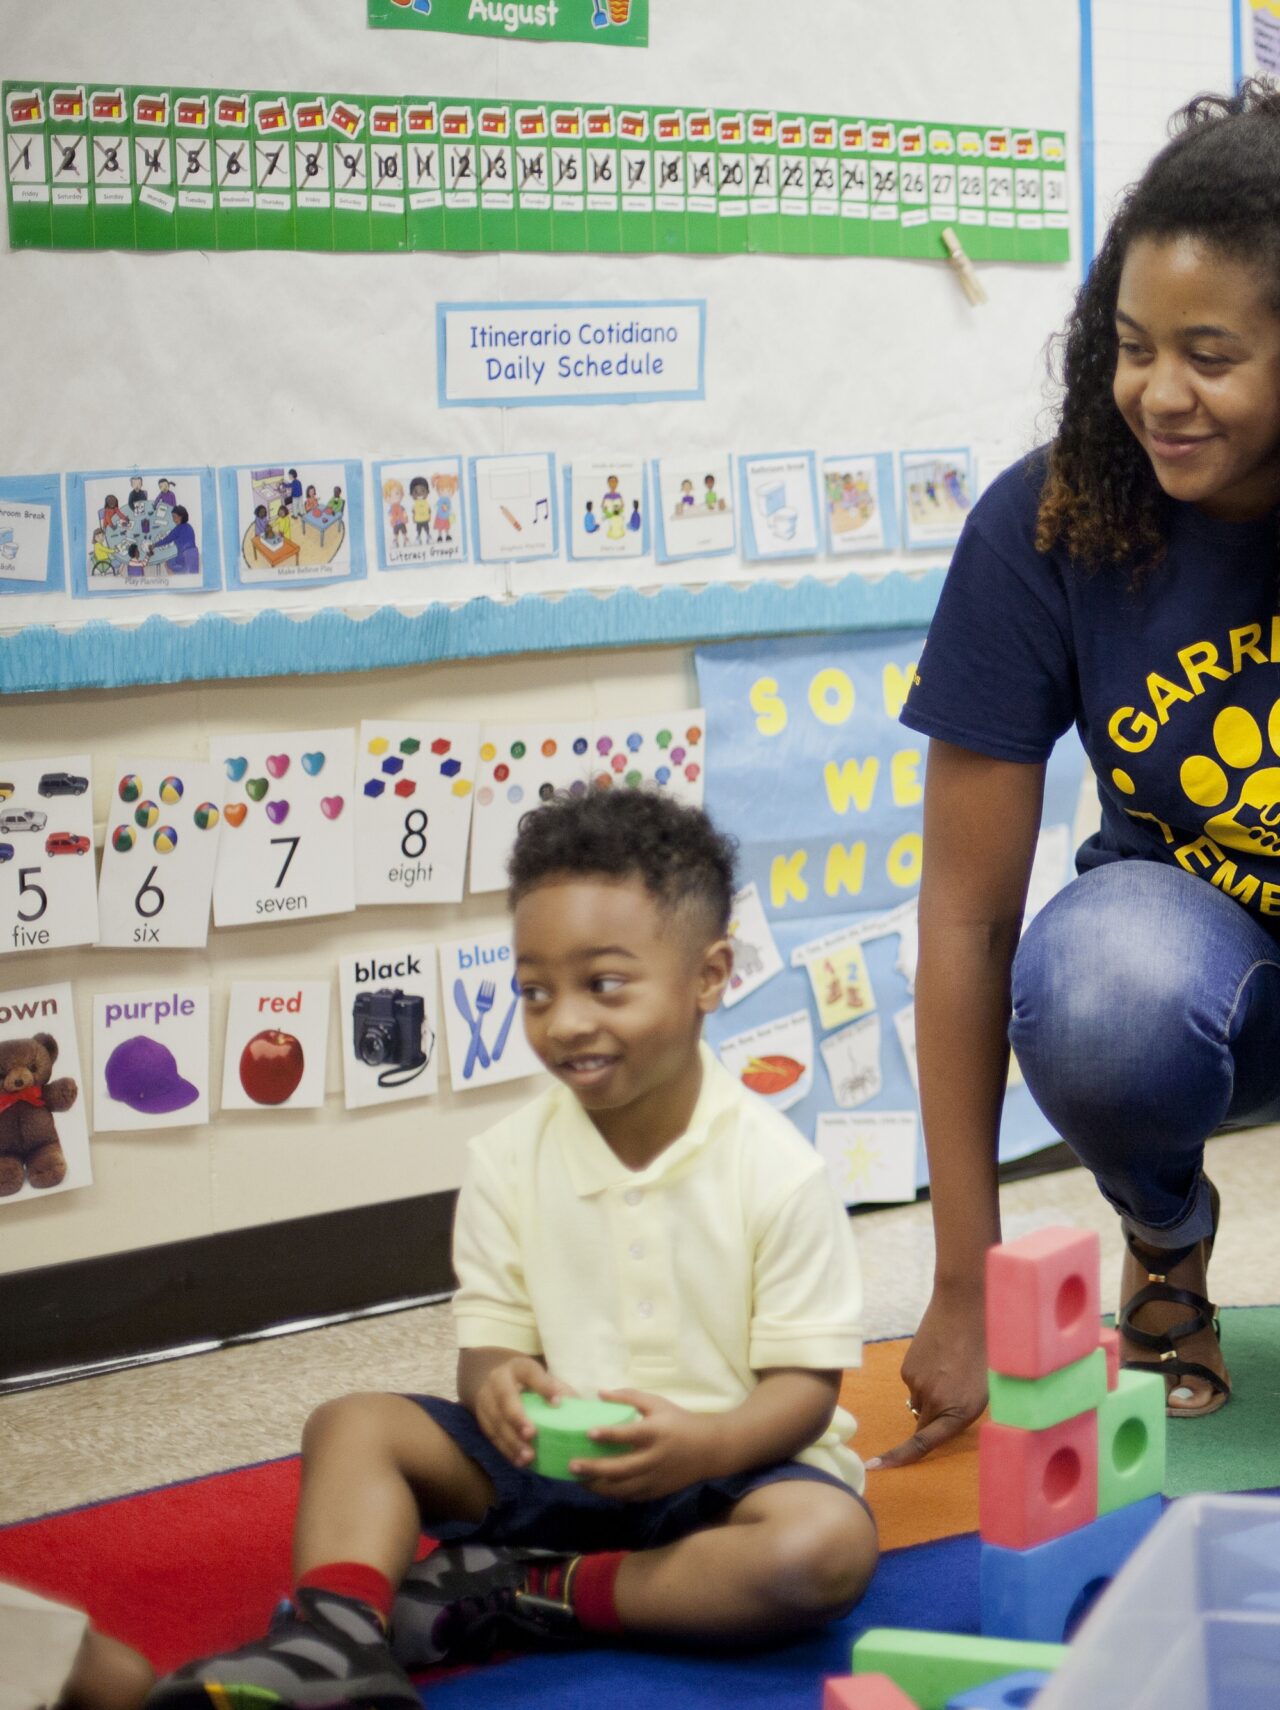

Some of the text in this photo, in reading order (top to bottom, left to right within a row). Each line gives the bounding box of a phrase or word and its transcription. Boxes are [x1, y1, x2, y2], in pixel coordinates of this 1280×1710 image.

[467, 0, 559, 33] August
[23, 145, 31, 171] 1
[62, 146, 78, 172] 2
[104, 147, 120, 173] 3
[144, 149, 162, 173] 4
[187, 150, 202, 174] 5
[226, 151, 242, 175] 6
[265, 151, 279, 176] 7
[305, 153, 319, 177] 8
[344, 154, 358, 178] 9
[378, 155, 398, 178] 10
[451, 156, 472, 178] 12
[487, 156, 507, 180] 13
[522, 157, 544, 180] 14
[558, 158, 578, 181] 15
[593, 159, 612, 182] 16
[628, 158, 646, 183] 17
[661, 160, 679, 184] 18
[694, 162, 710, 184] 19
[721, 163, 744, 186] 20
[753, 165, 770, 186] 21
[783, 166, 803, 187] 22
[814, 168, 834, 188] 23
[843, 171, 865, 191] 24
[875, 172, 896, 192] 25
[904, 173, 924, 193] 26
[932, 174, 951, 194] 27
[961, 176, 981, 197] 28
[989, 177, 1009, 198] 29
[1017, 179, 1038, 199] 30
[1047, 180, 1062, 199] 31
[470, 321, 679, 348] Itinerario Cotidiano
[486, 352, 665, 386] Daily Schedule
[24, 511, 46, 520] Break
[388, 545, 459, 562] Literacy Groups
[125, 577, 170, 586] Play Planning
[823, 749, 924, 815] WE
[401, 809, 428, 858] 8
[270, 837, 301, 888] 7
[388, 862, 434, 888] eight
[17, 867, 48, 922] 5
[134, 866, 164, 918] 6
[256, 895, 308, 914] seven
[12, 925, 51, 947] five
[133, 923, 160, 943] six
[354, 955, 422, 983] black
[457, 944, 511, 970] blue
[0, 998, 58, 1024] own
[105, 993, 196, 1027] purple
[257, 991, 303, 1014] red
